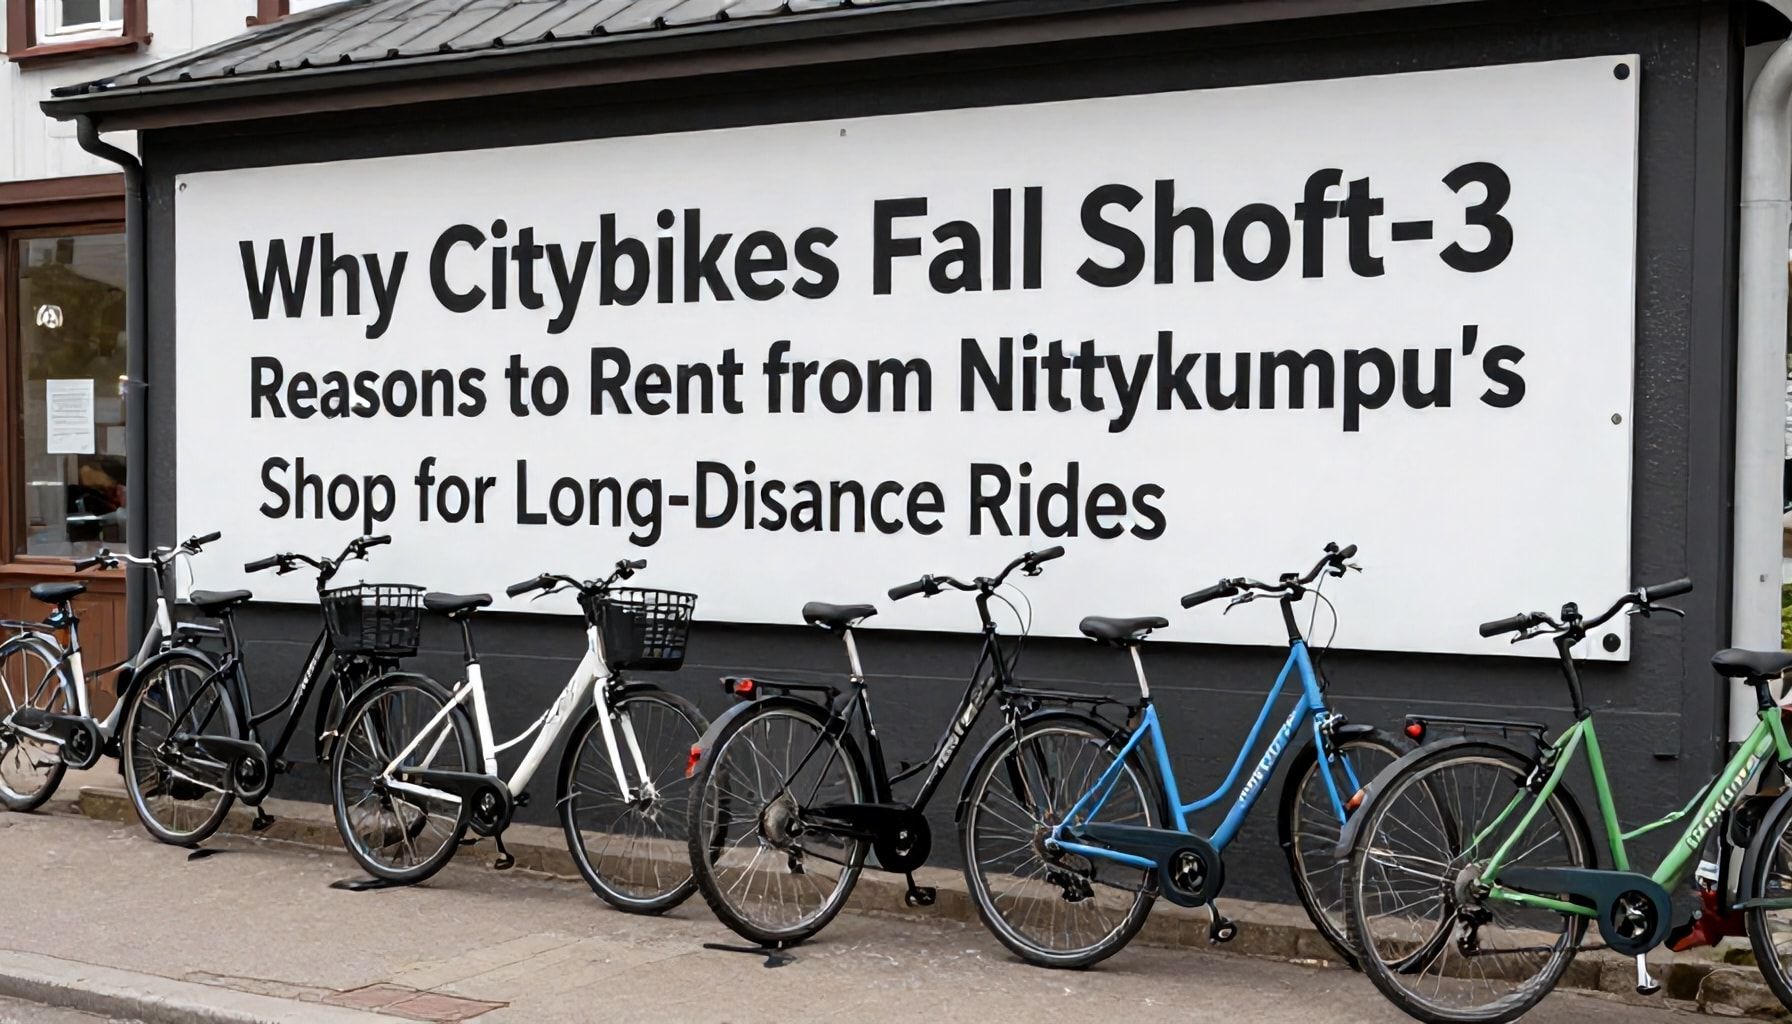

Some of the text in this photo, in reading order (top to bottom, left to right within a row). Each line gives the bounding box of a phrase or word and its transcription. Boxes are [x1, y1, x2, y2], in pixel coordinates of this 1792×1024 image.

[239, 161, 1514, 340] Why Citybikes Fall Shoft-3
[250, 324, 1526, 434] Reasons to Rent from Nittykumpu's
[259, 456, 1167, 548] Shop for Long-Disance Rides
